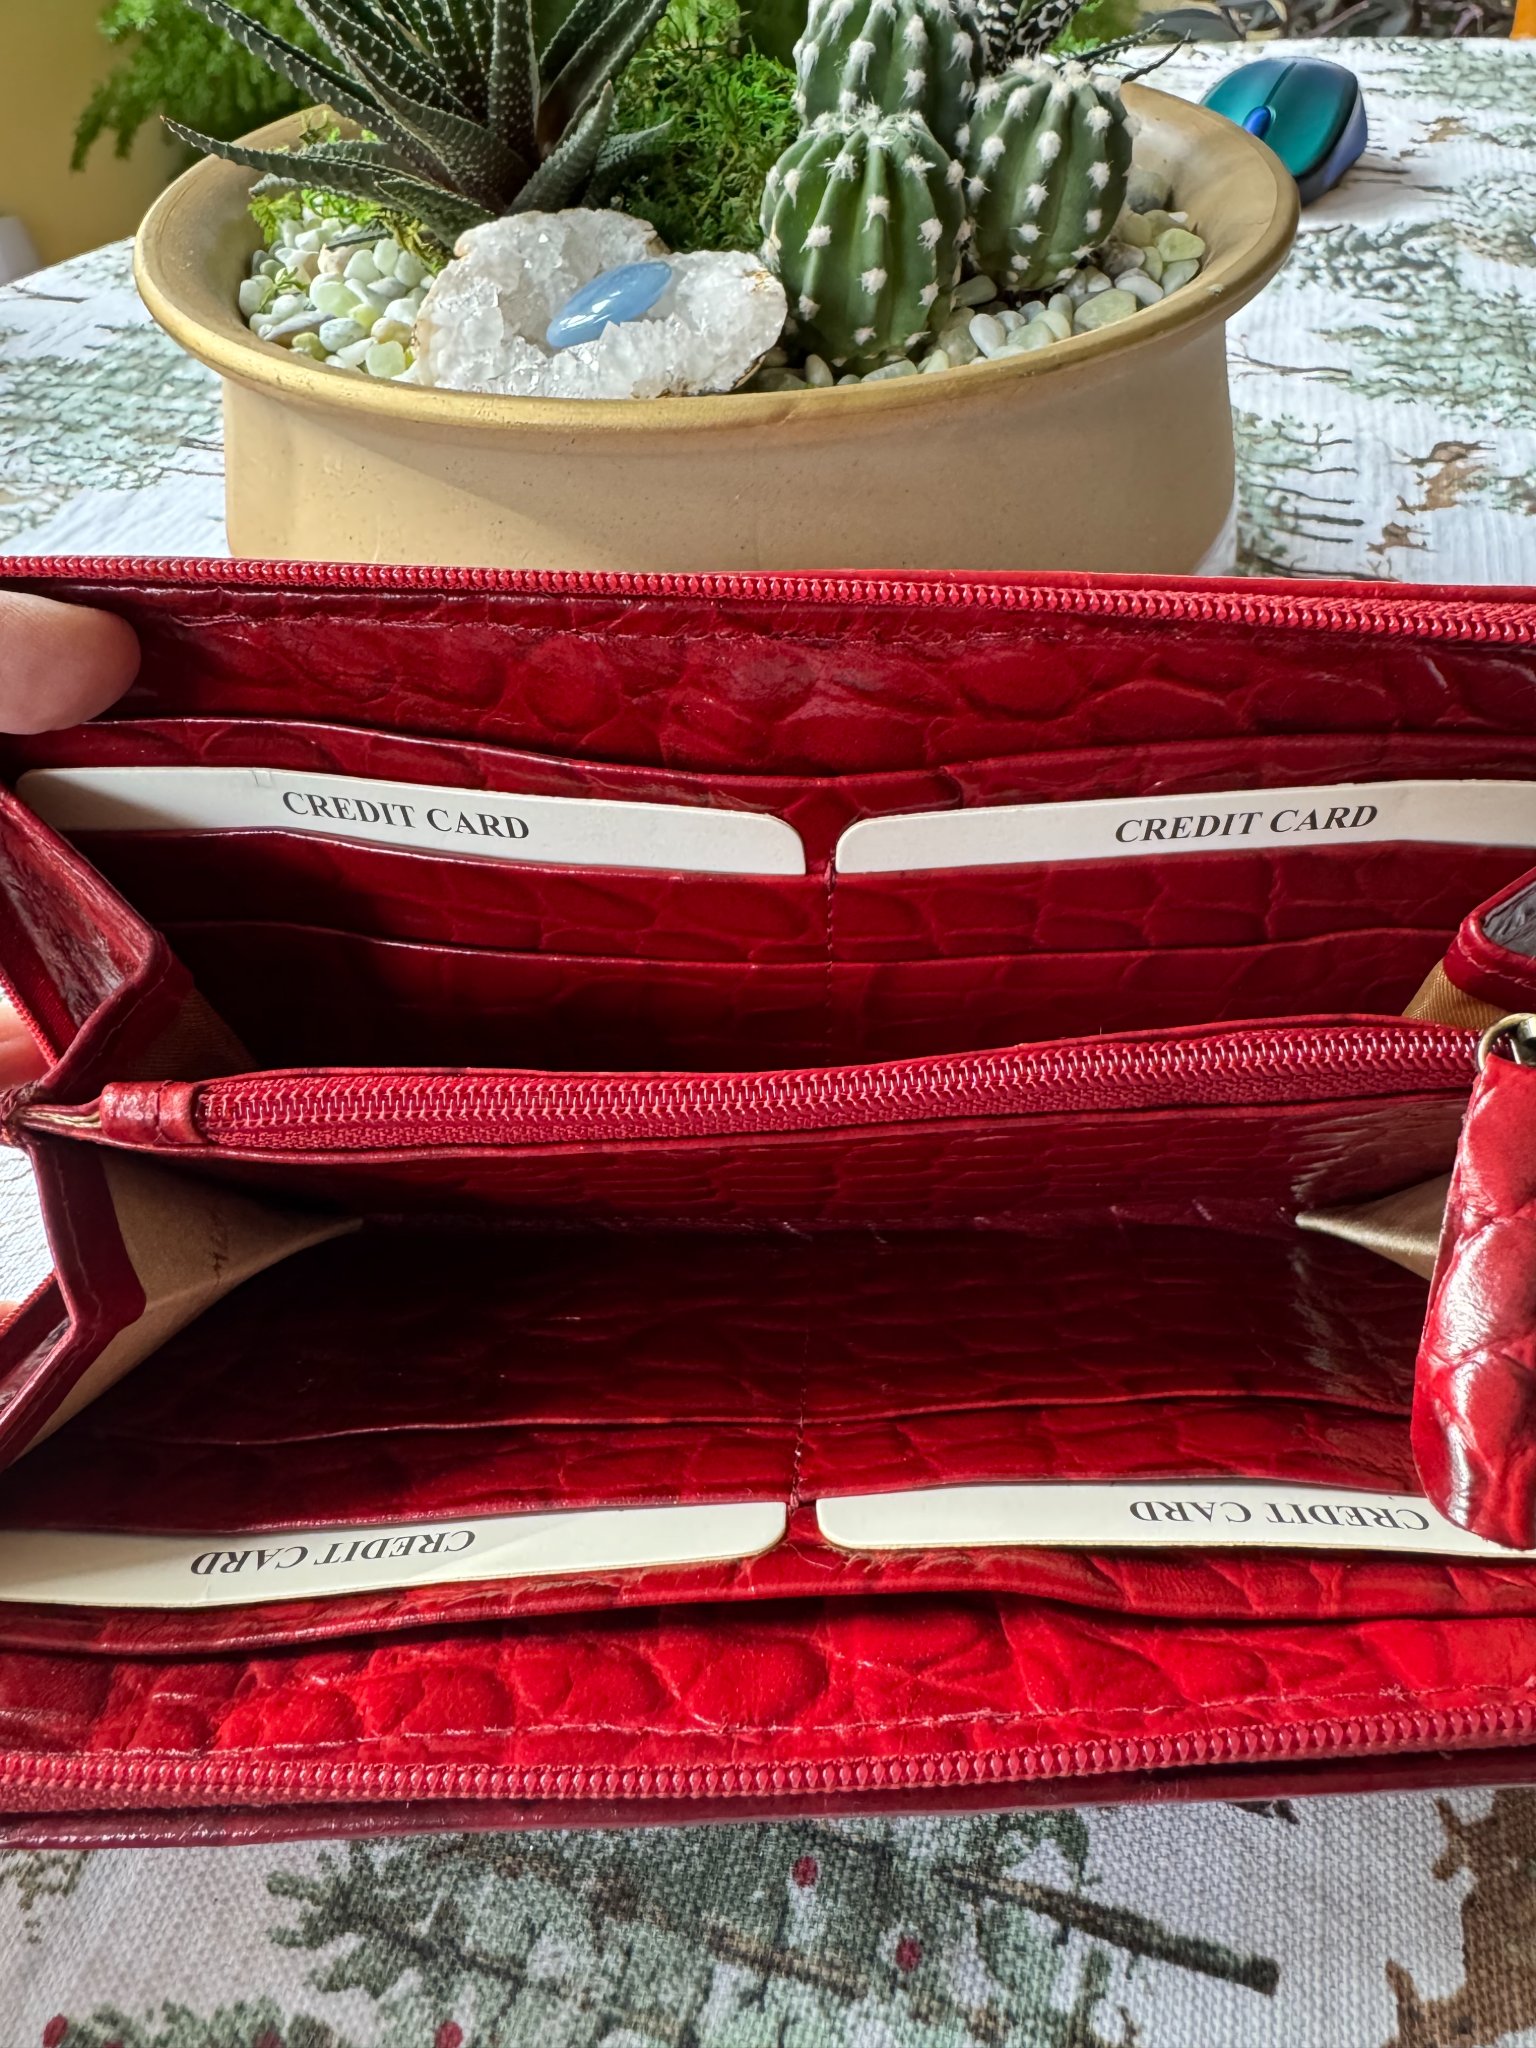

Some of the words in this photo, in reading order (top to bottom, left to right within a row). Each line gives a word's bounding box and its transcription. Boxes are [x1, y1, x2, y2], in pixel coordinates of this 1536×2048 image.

[282, 791, 416, 828] CREDIT
[426, 808, 530, 839] CARD
[1115, 811, 1263, 843] CREDIT
[1269, 805, 1378, 833] CARD
[1129, 1501, 1252, 1523] CARD
[1264, 1502, 1430, 1531] CREDIT
[190, 1545, 309, 1575] CARD
[313, 1530, 476, 1565] CREDIT
